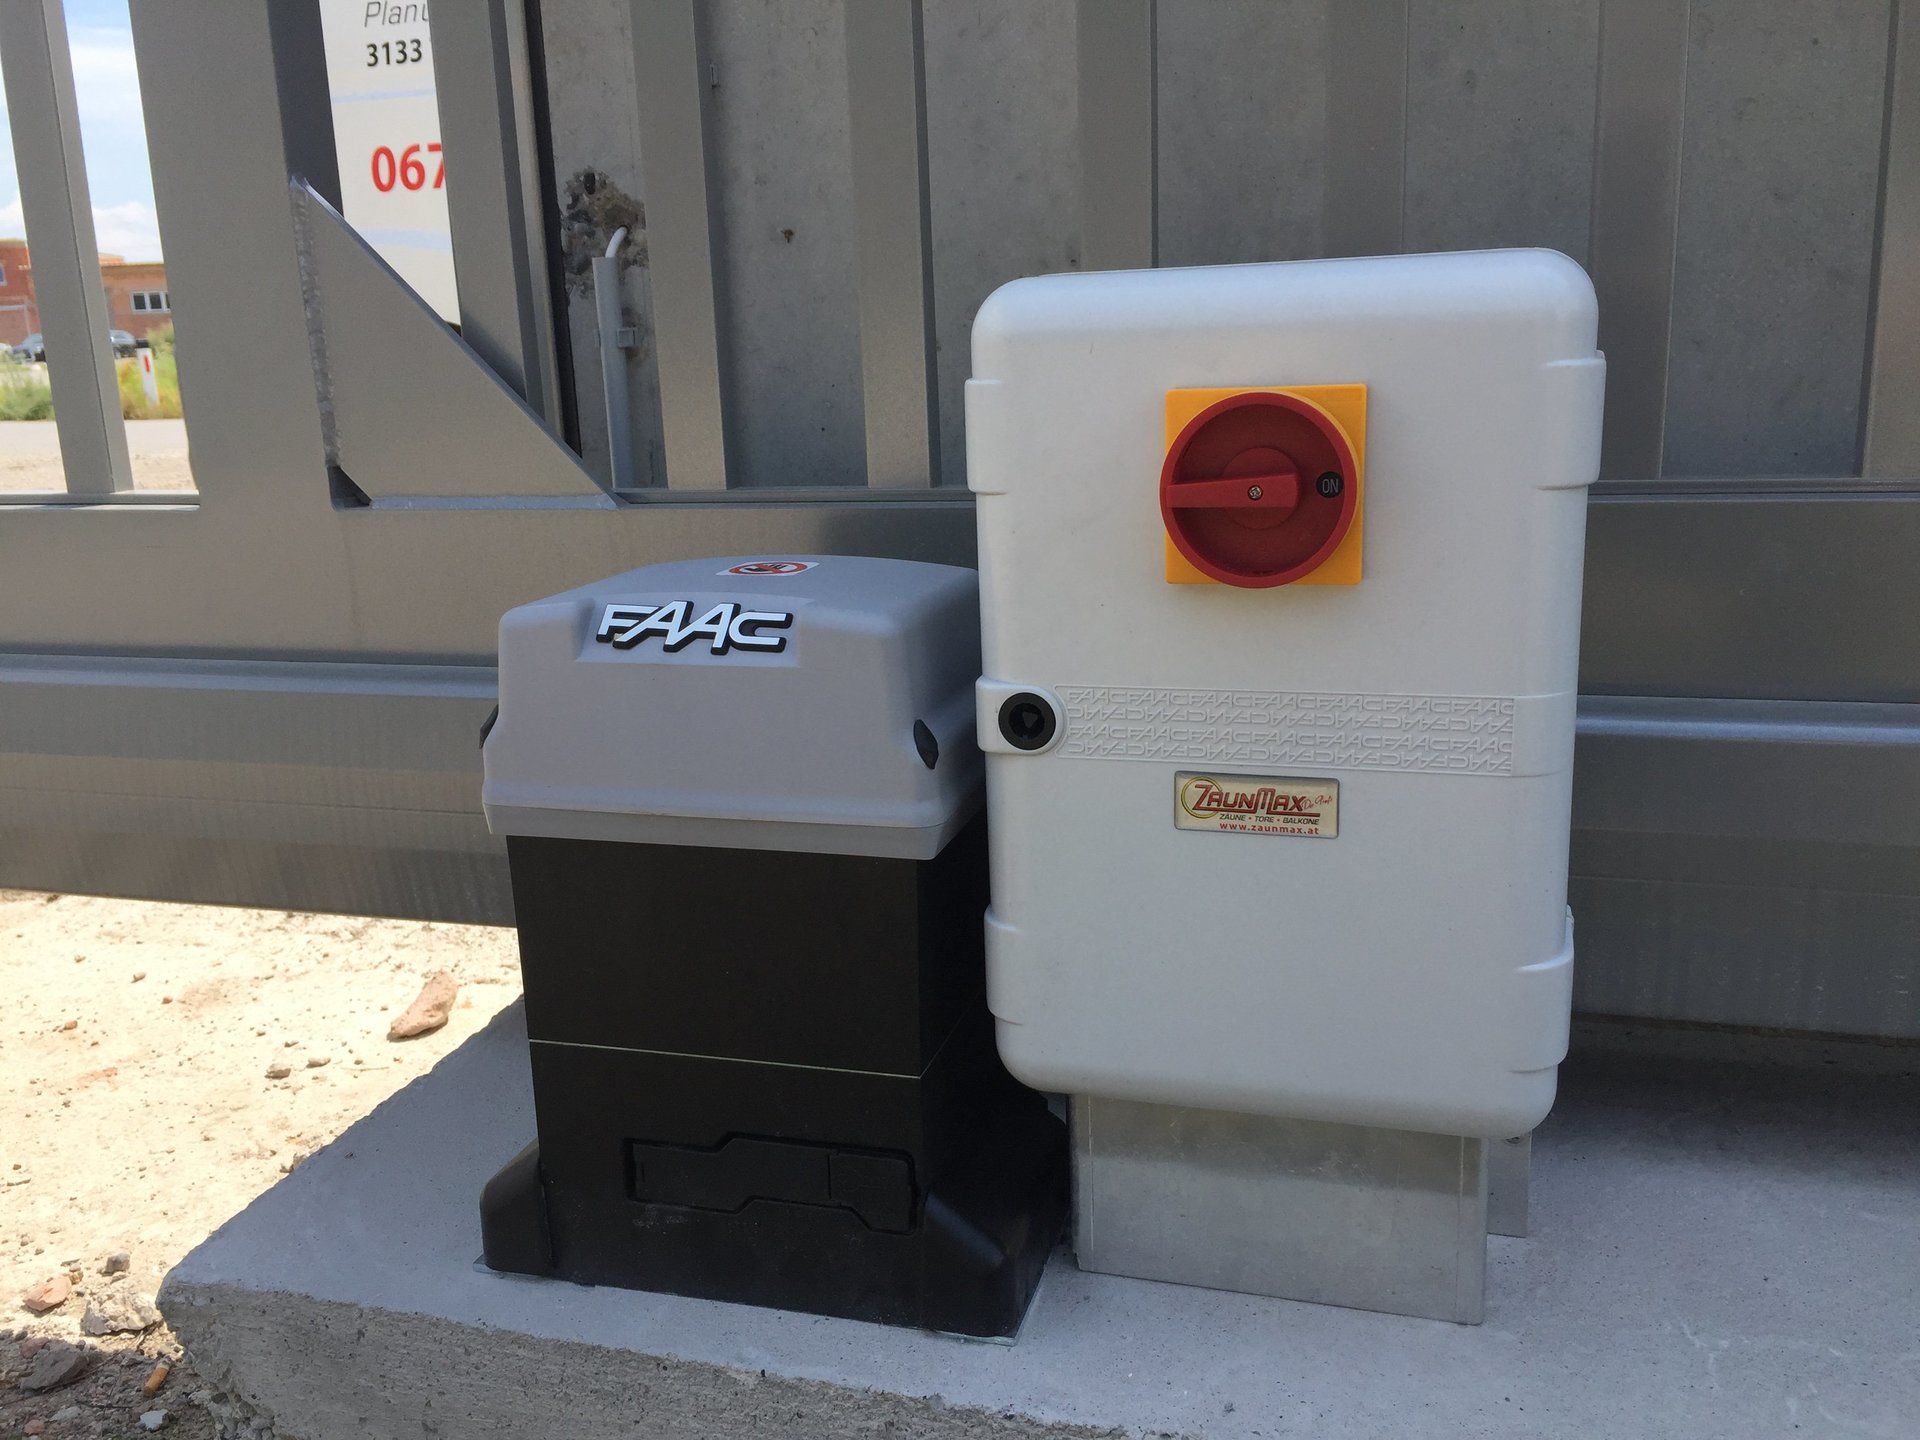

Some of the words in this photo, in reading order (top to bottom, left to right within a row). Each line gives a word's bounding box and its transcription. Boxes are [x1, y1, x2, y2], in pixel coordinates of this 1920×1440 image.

[366, 39, 422, 67] 3133
[371, 143, 445, 192] 067
[1322, 478, 1339, 494] ON
[596, 600, 793, 656] FAAC
[1219, 822, 1319, 835] www.zaunmax.at
[1255, 815, 1274, 823] TORE
[1282, 817, 1320, 825] BALKONE
